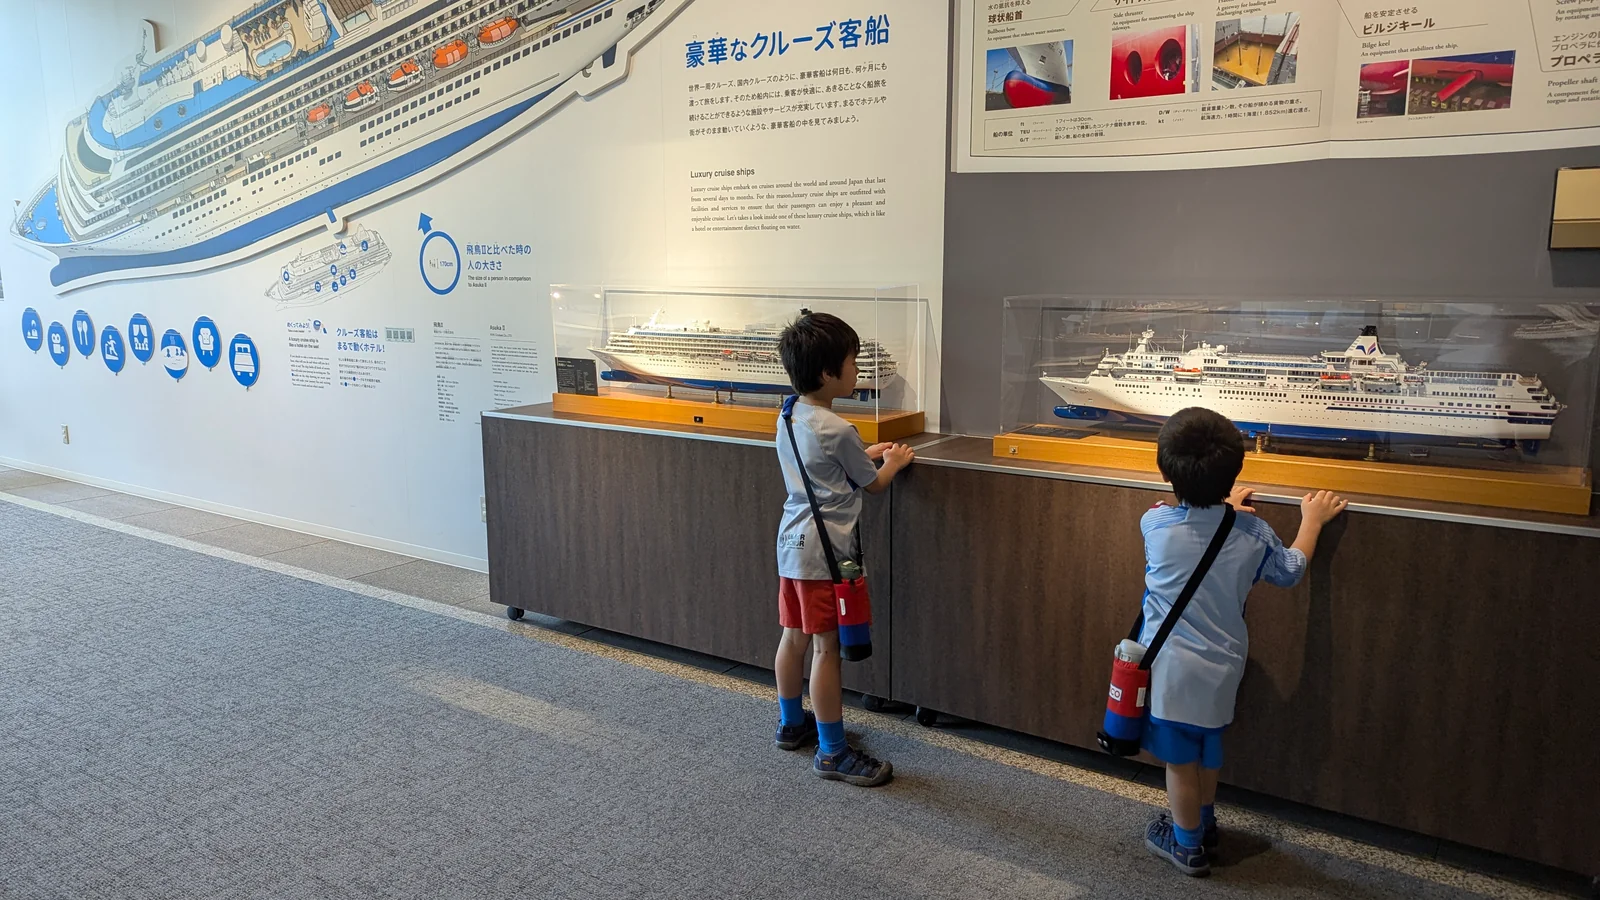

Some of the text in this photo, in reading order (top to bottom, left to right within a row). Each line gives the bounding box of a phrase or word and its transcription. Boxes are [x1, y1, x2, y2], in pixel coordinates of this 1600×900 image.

[988, 10, 1023, 23] 球状船首
[1364, 7, 1418, 19] 船を安定させる
[1363, 18, 1435, 35] ビルジキール
[685, 14, 890, 68] 豪華なクルーズ客船
[1552, 31, 1600, 42] エンジンの
[1548, 78, 1579, 87] Propeller
[691, 171, 712, 179] Luxury
[736, 168, 755, 177] ships
[468, 260, 502, 271] 人の大きさ
[336, 328, 378, 338] クルーズ客船は
[338, 342, 385, 352] まるで動くホテル!
